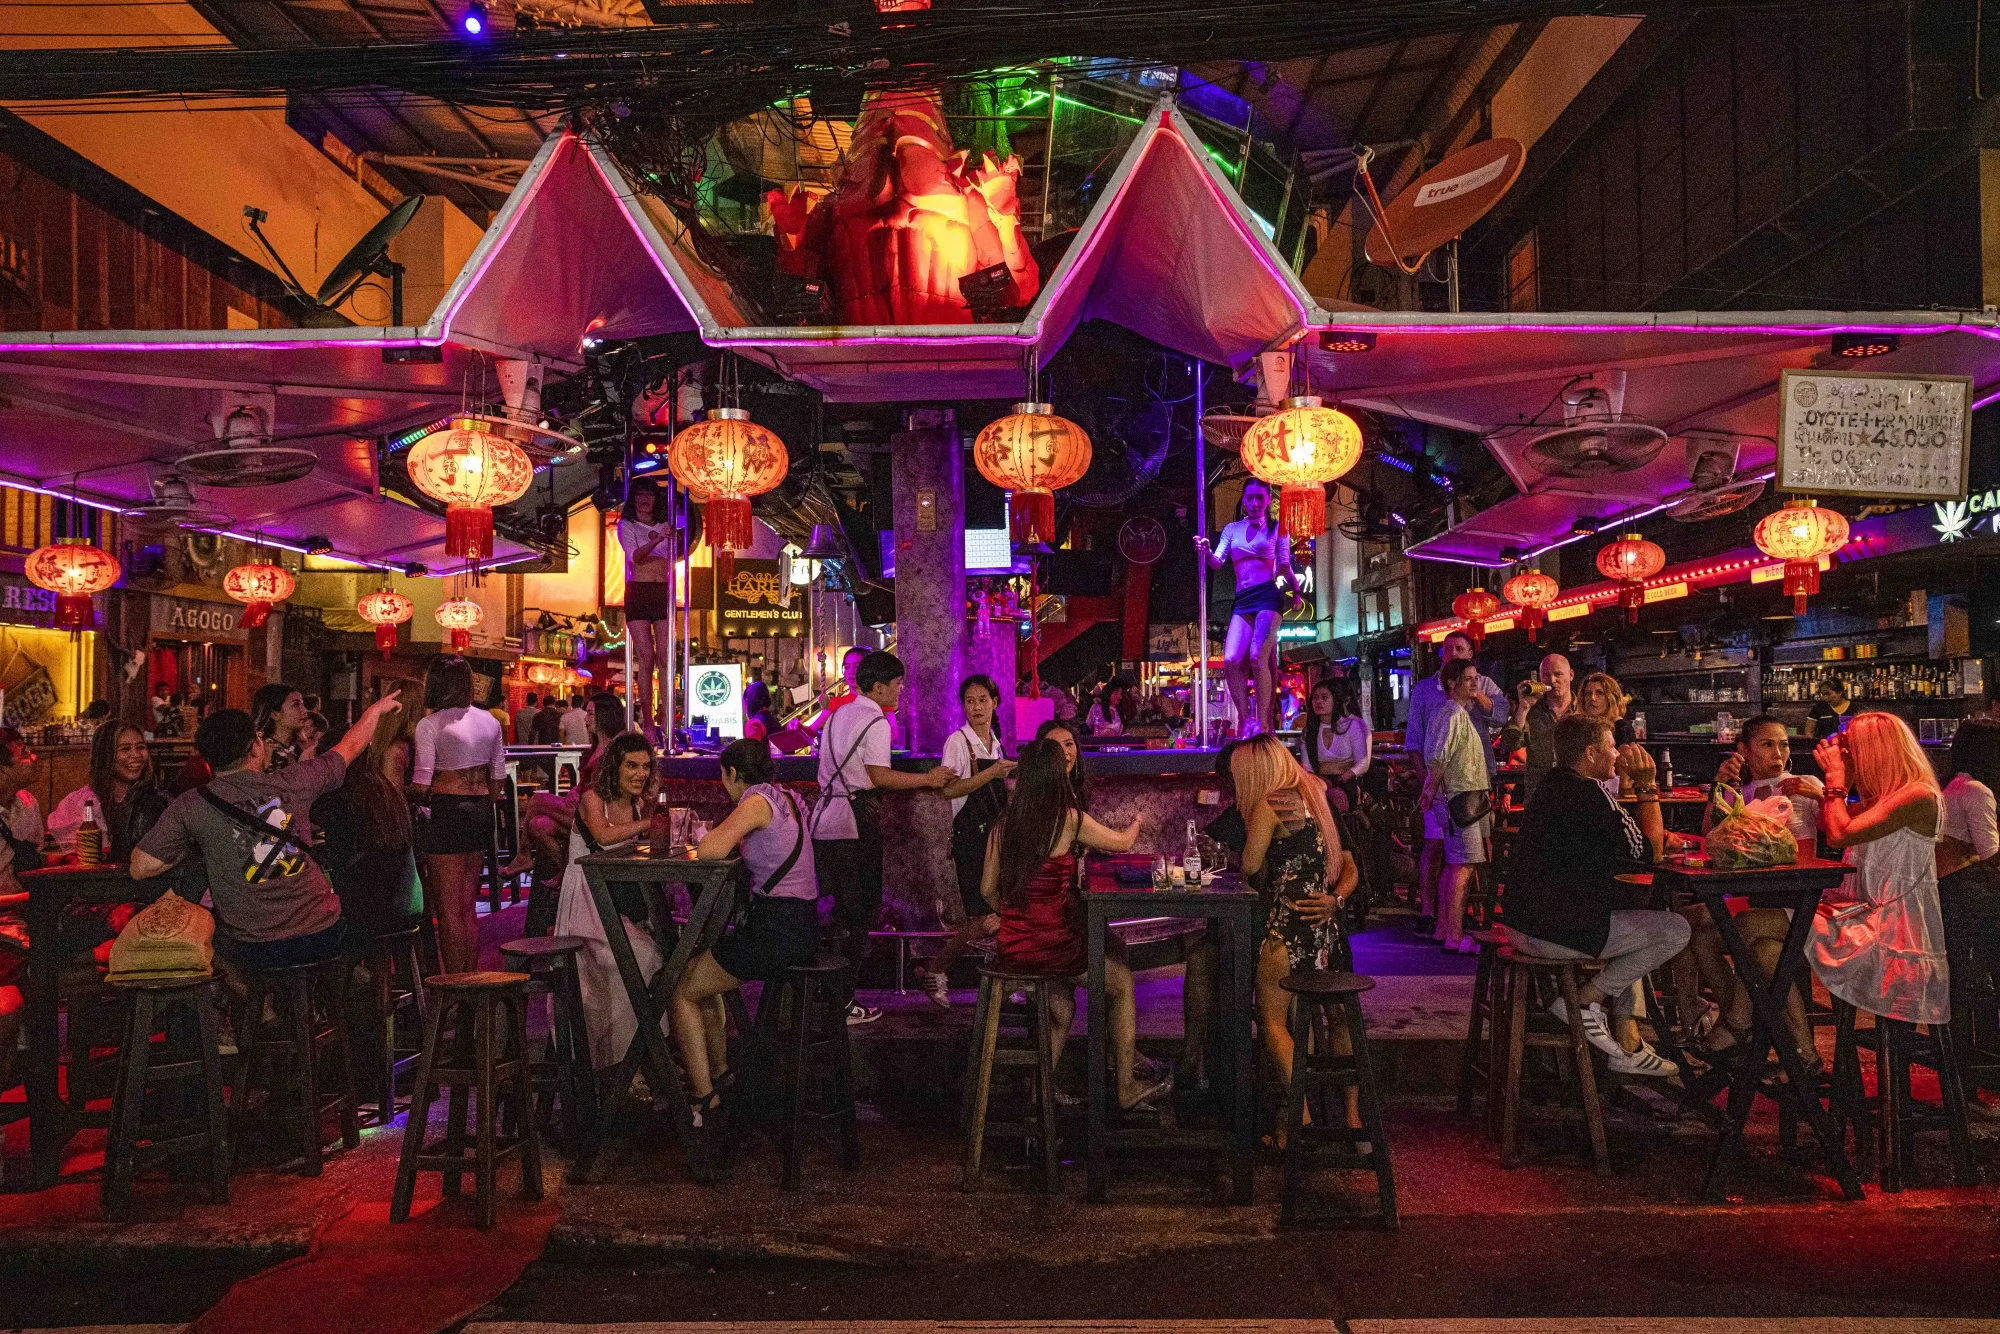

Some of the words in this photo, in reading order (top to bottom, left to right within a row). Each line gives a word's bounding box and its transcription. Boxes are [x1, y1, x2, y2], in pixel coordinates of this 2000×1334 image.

[1427, 183, 1459, 198] true
[1969, 489, 2000, 513] CA
[171, 607, 234, 631] AGOGO
[724, 609, 780, 619] GENTLEMEN'S
